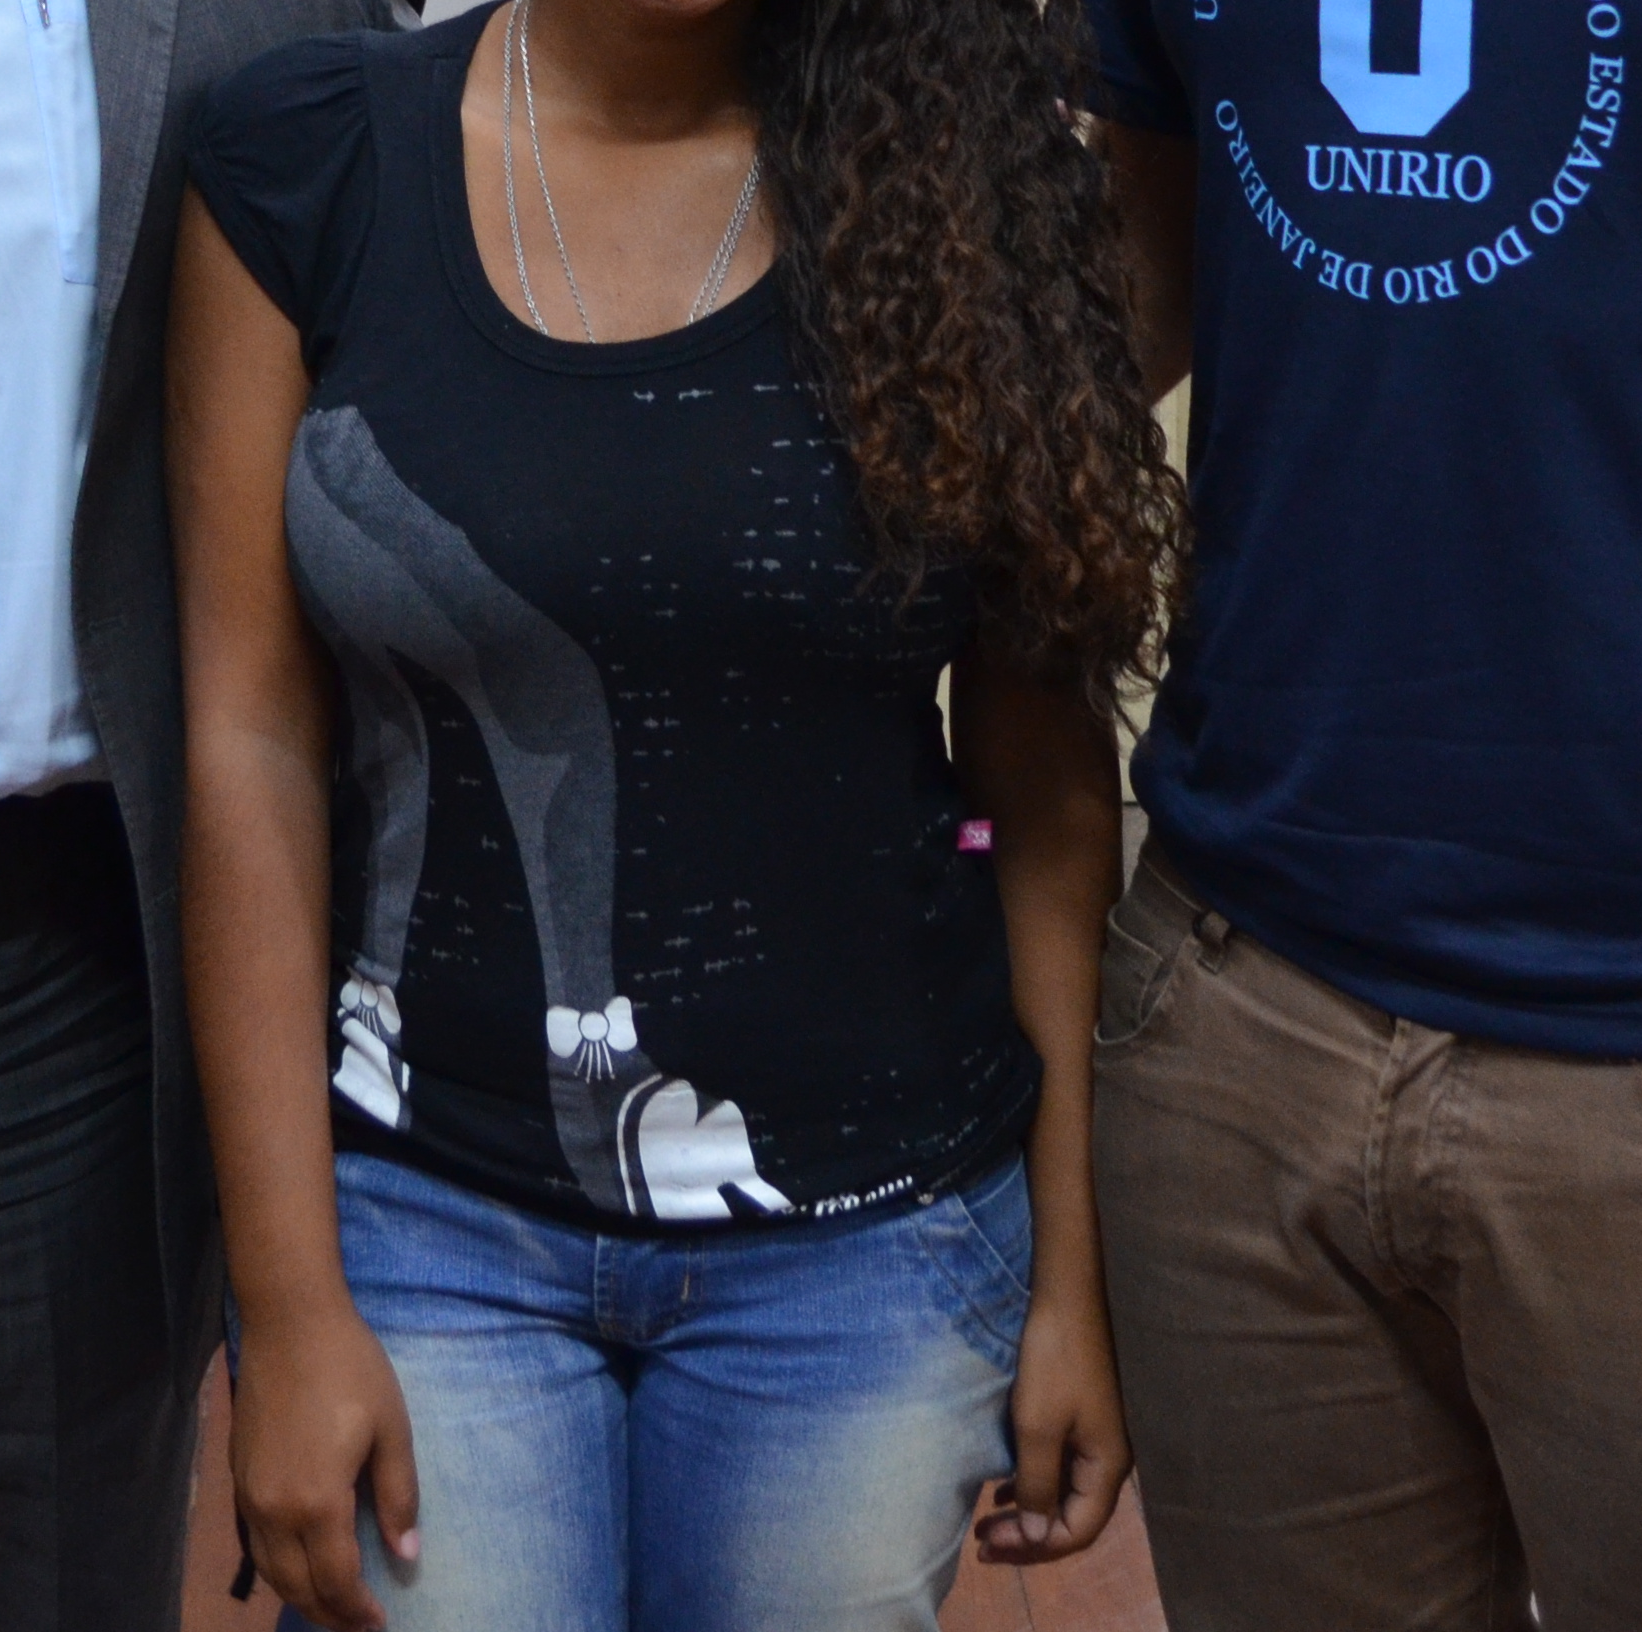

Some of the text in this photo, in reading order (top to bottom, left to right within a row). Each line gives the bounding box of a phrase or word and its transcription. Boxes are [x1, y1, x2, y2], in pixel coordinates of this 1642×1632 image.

[1304, 144, 1492, 203] UNIRIO
[1530, 53, 1624, 235] ESTADO
[1215, 100, 1316, 270] JANEIRO
[1318, 249, 1373, 300] DE
[1383, 259, 1460, 304] RIO
[1466, 225, 1533, 284] DO
